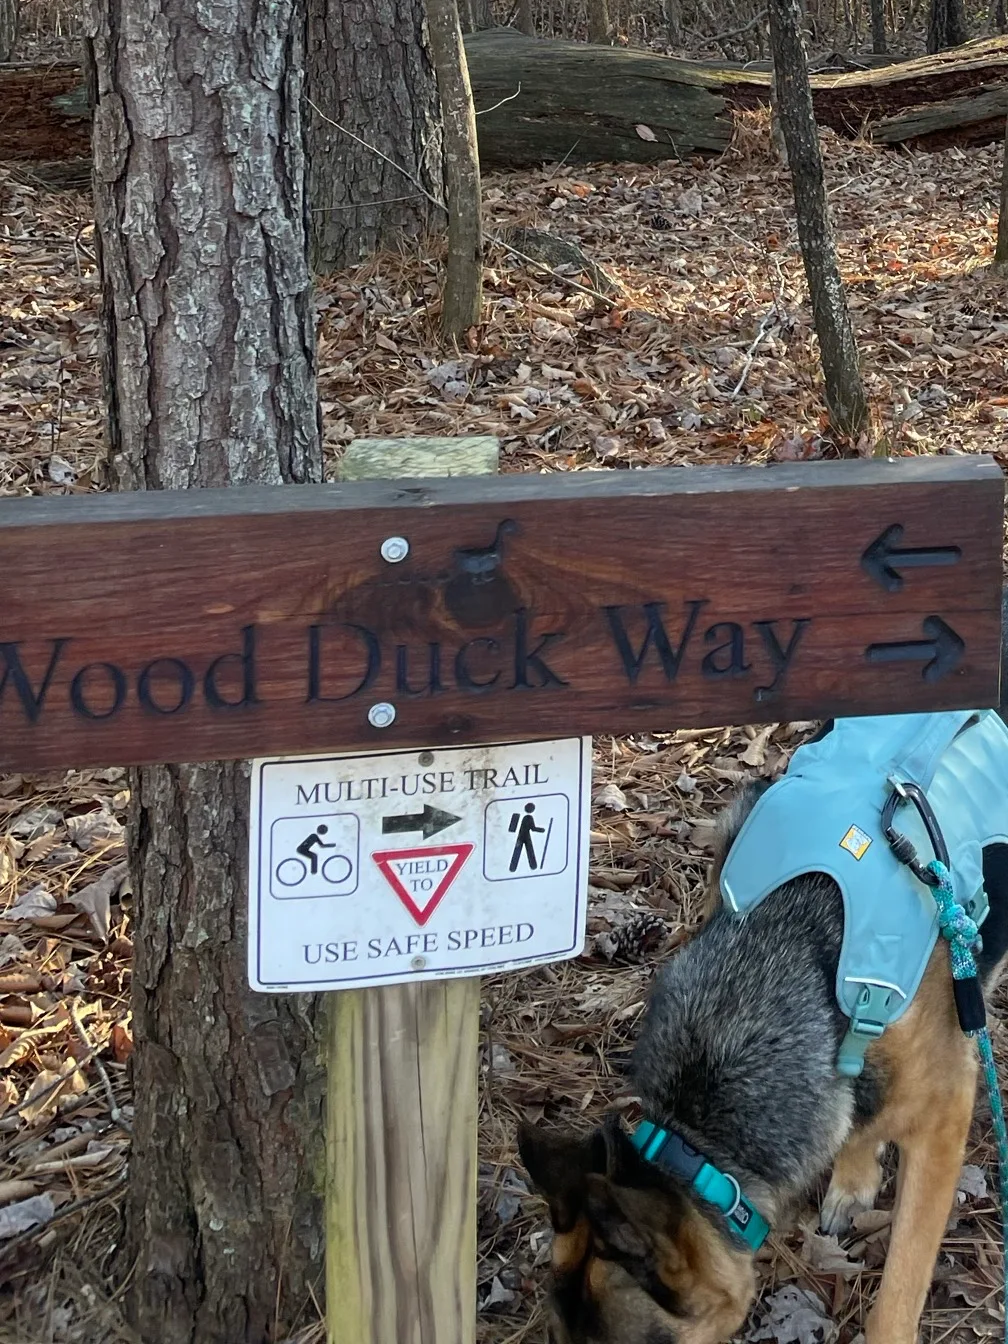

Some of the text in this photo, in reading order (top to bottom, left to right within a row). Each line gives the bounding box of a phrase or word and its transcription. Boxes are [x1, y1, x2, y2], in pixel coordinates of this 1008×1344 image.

[304, 606, 571, 704] Duck
[601, 599, 812, 702] Way
[295, 763, 549, 805] MULTI-USE TRAIL
[394, 859, 449, 876] YIELD
[410, 878, 434, 892] TO
[303, 922, 535, 965] USE SAFE SPEED
